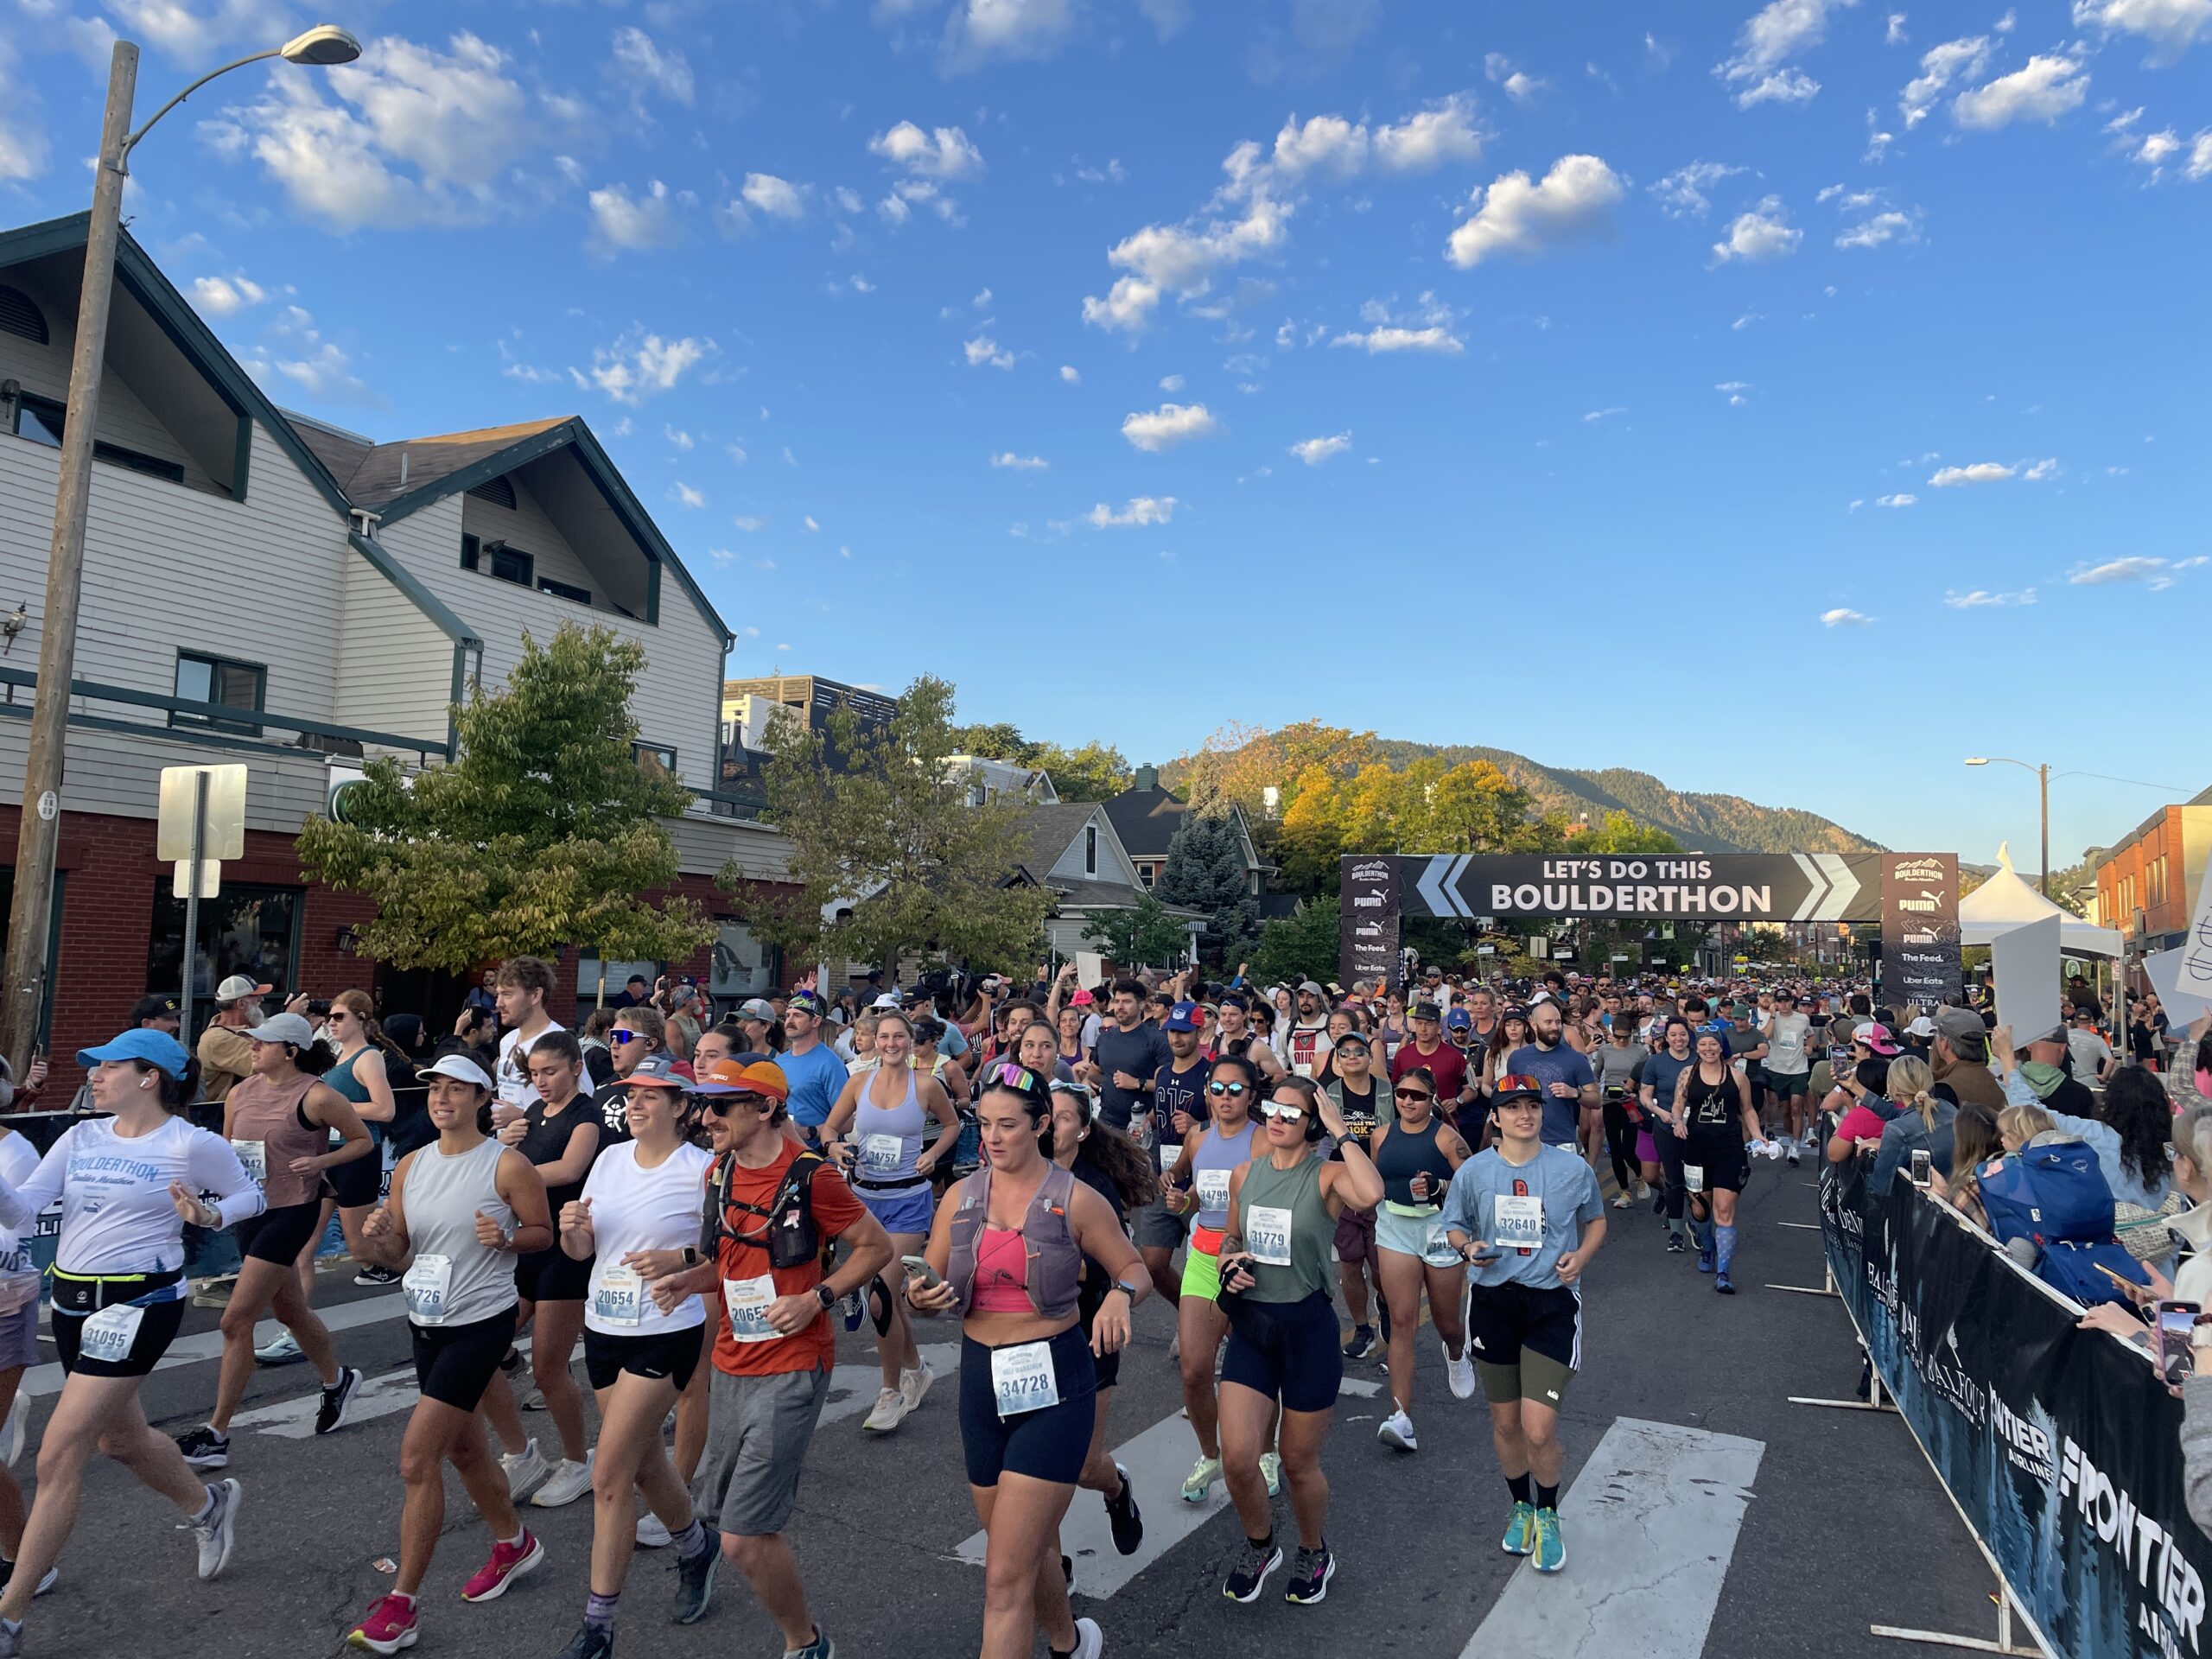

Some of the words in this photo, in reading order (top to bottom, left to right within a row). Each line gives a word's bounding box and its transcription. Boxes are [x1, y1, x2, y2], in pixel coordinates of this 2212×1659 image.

[1351, 869, 1389, 880] BOULDERTHON
[1543, 860, 1603, 880] LET'S
[1610, 861, 1648, 880] DO
[1656, 861, 1713, 880] THIS
[1894, 868, 1943, 880] BOULDERTHON
[1354, 897, 1382, 907] PUMA
[1491, 884, 1771, 912] BOULDERTHON
[1899, 899, 1936, 912] PUMA
[1356, 927, 1379, 936] PUMA
[1903, 933, 1933, 944] PUMA
[1354, 944, 1368, 952] The
[1902, 953, 1919, 962] The
[1919, 953, 1944, 963] Feed.
[1370, 963, 1386, 972] Eats
[1923, 976, 1943, 985] Eats
[1906, 998, 1941, 1007] ULTRA
[870, 1151, 897, 1163] 34757
[69, 1157, 160, 1183] BOULDERTHON
[1200, 1190, 1229, 1201] 34799
[1500, 1217, 1536, 1231] 32640
[1251, 1230, 1285, 1246] 31779
[598, 1289, 634, 1306] 20654
[86, 1328, 128, 1348] 31095
[1001, 1373, 1049, 1398] 34728
[1928, 1353, 1986, 1425] BALFOUR
[2060, 1434, 2206, 1656] FRONTIER
